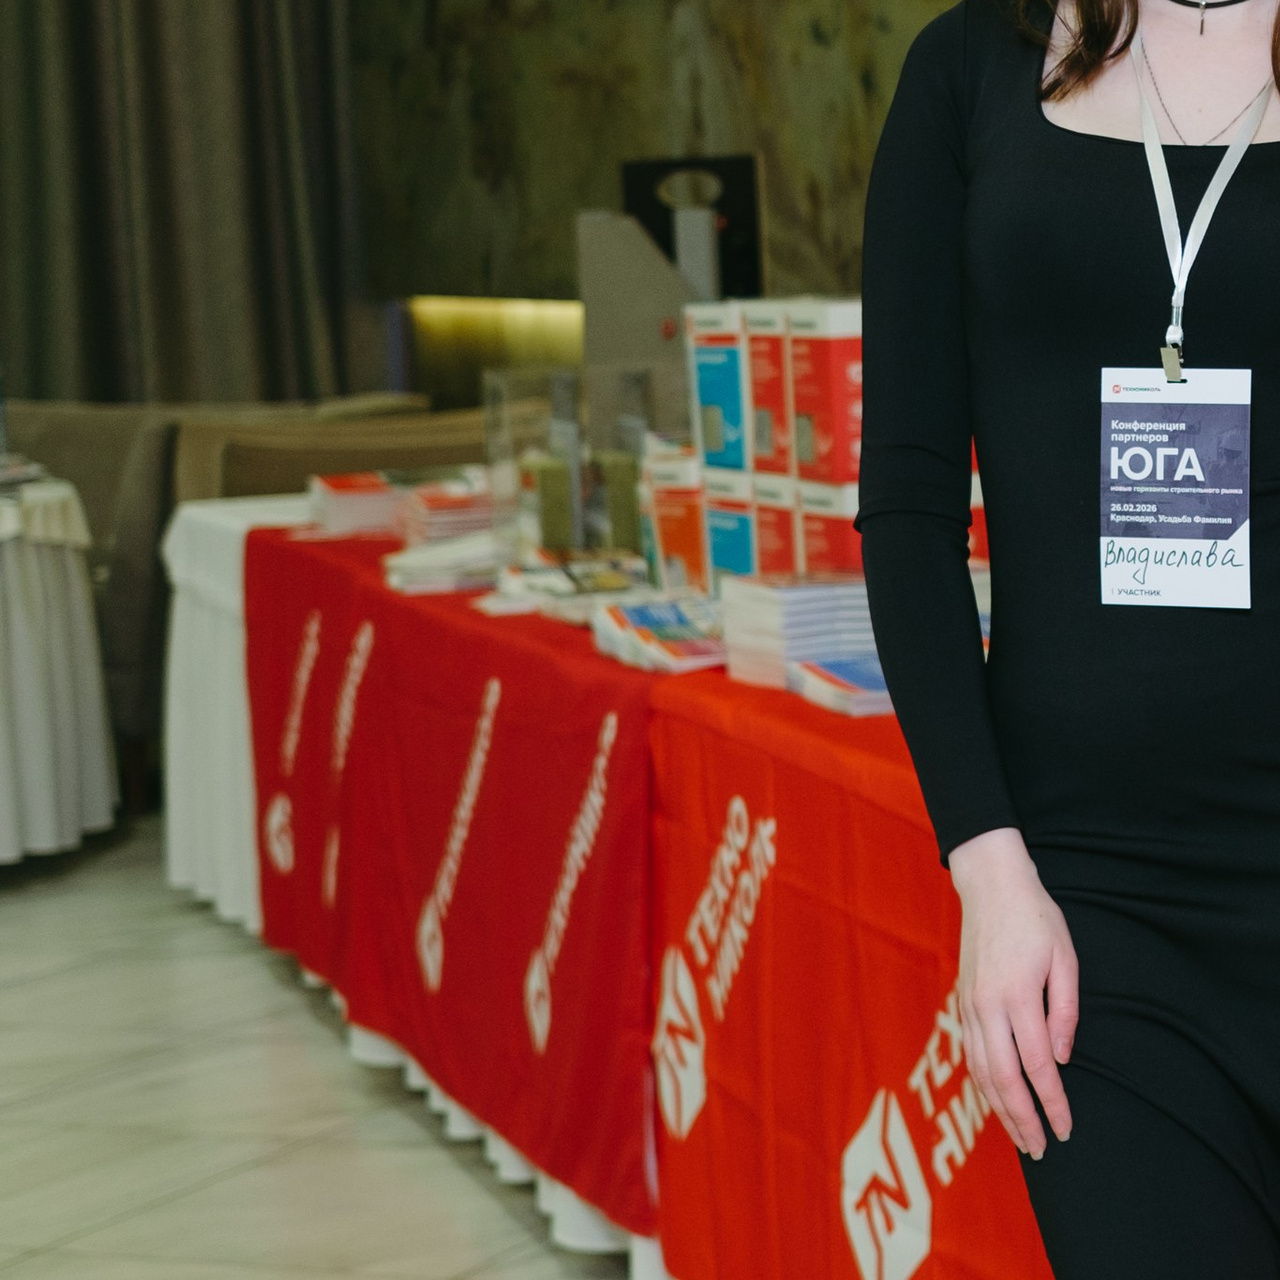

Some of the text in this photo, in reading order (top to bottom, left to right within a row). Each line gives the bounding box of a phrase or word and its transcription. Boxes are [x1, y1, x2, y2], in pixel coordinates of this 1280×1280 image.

[1111, 420, 1186, 432] Конференция
[1111, 433, 1169, 443] партнеров
[1110, 446, 1205, 482] ЮГА
[1133, 486, 1169, 494] горизонты
[1170, 487, 1220, 495] строительного
[1111, 503, 1157, 512] 26.02.2026
[1158, 515, 1192, 524] Усадьба
[1104, 539, 1244, 585] Владислава
[1118, 588, 1161, 597] УЧАСТНИК
[908, 976, 963, 1118] ТЕХ
